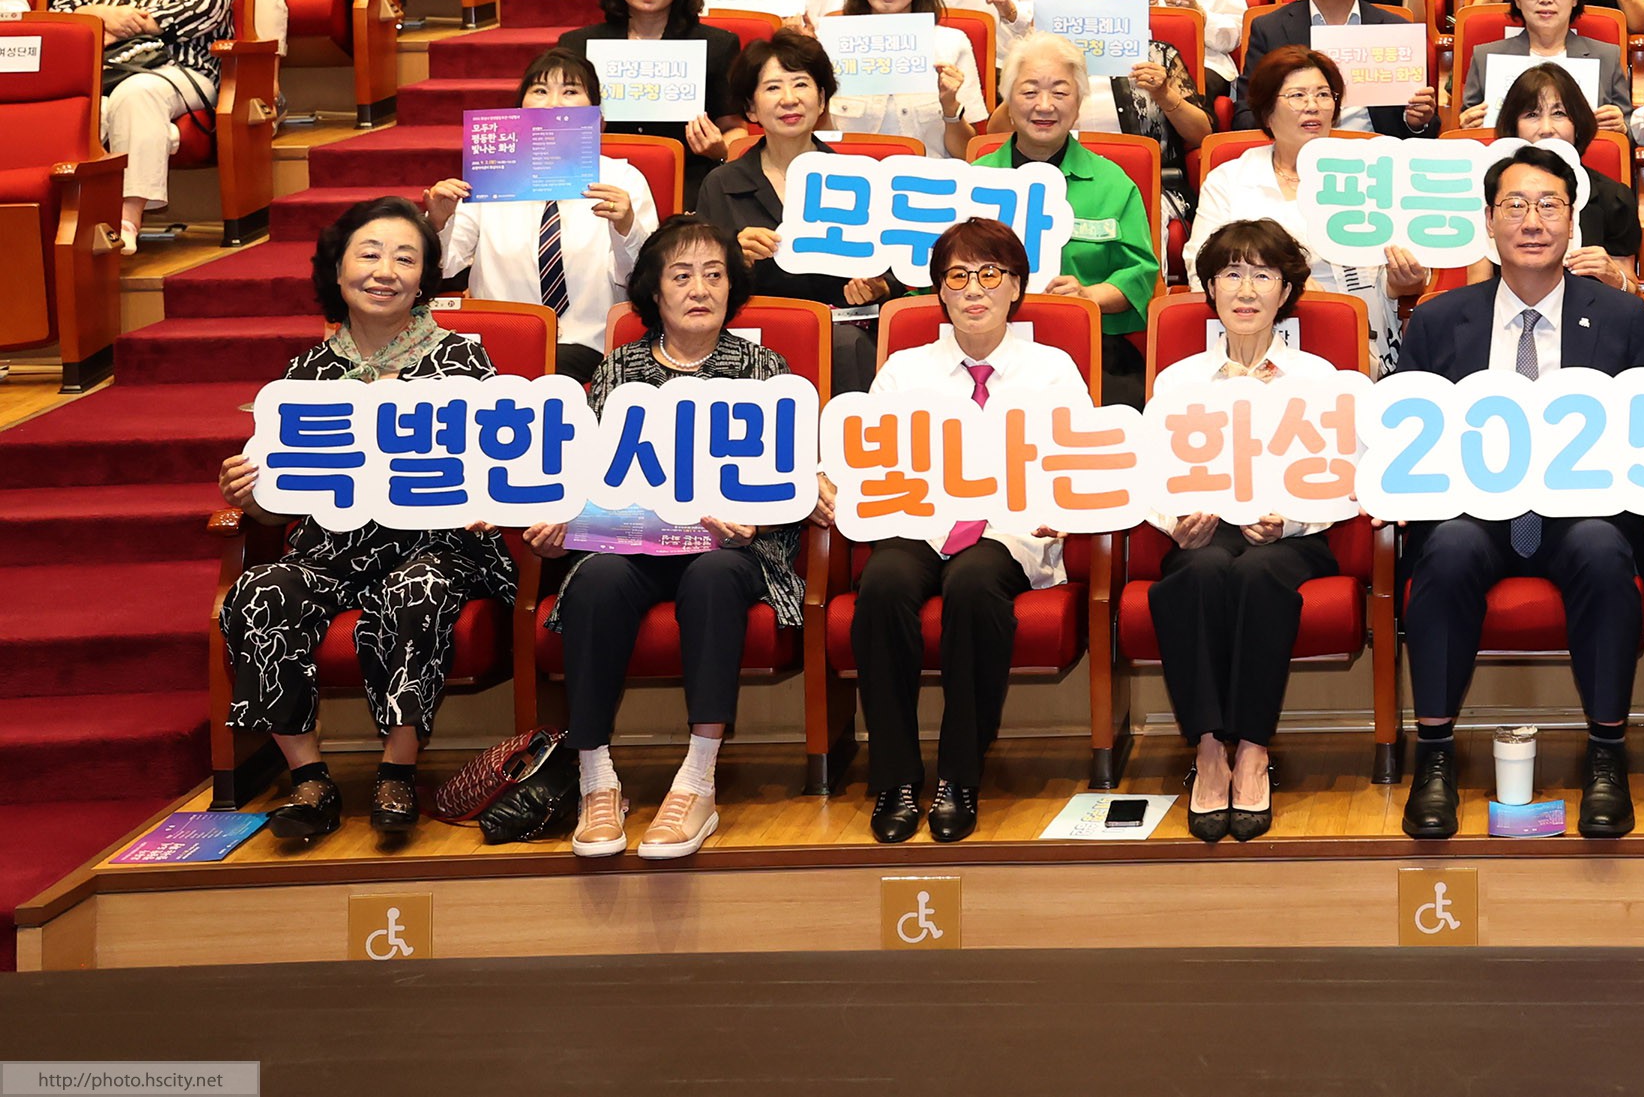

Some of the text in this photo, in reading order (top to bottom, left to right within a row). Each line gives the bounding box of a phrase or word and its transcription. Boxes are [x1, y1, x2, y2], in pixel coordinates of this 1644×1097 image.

[1051, 16, 1131, 35] 화성특례시
[838, 34, 917, 54] 화성특례시
[1108, 37, 1140, 58] 승인
[606, 60, 688, 79] 화성특례시
[861, 56, 892, 75] 구청
[895, 55, 927, 75] 승인
[627, 82, 661, 102] 구청
[664, 82, 697, 101] 승인
[792, 171, 1053, 274] 모두가
[266, 397, 796, 509] 특별한 시민
[843, 393, 1357, 519] 빛나는 화성
